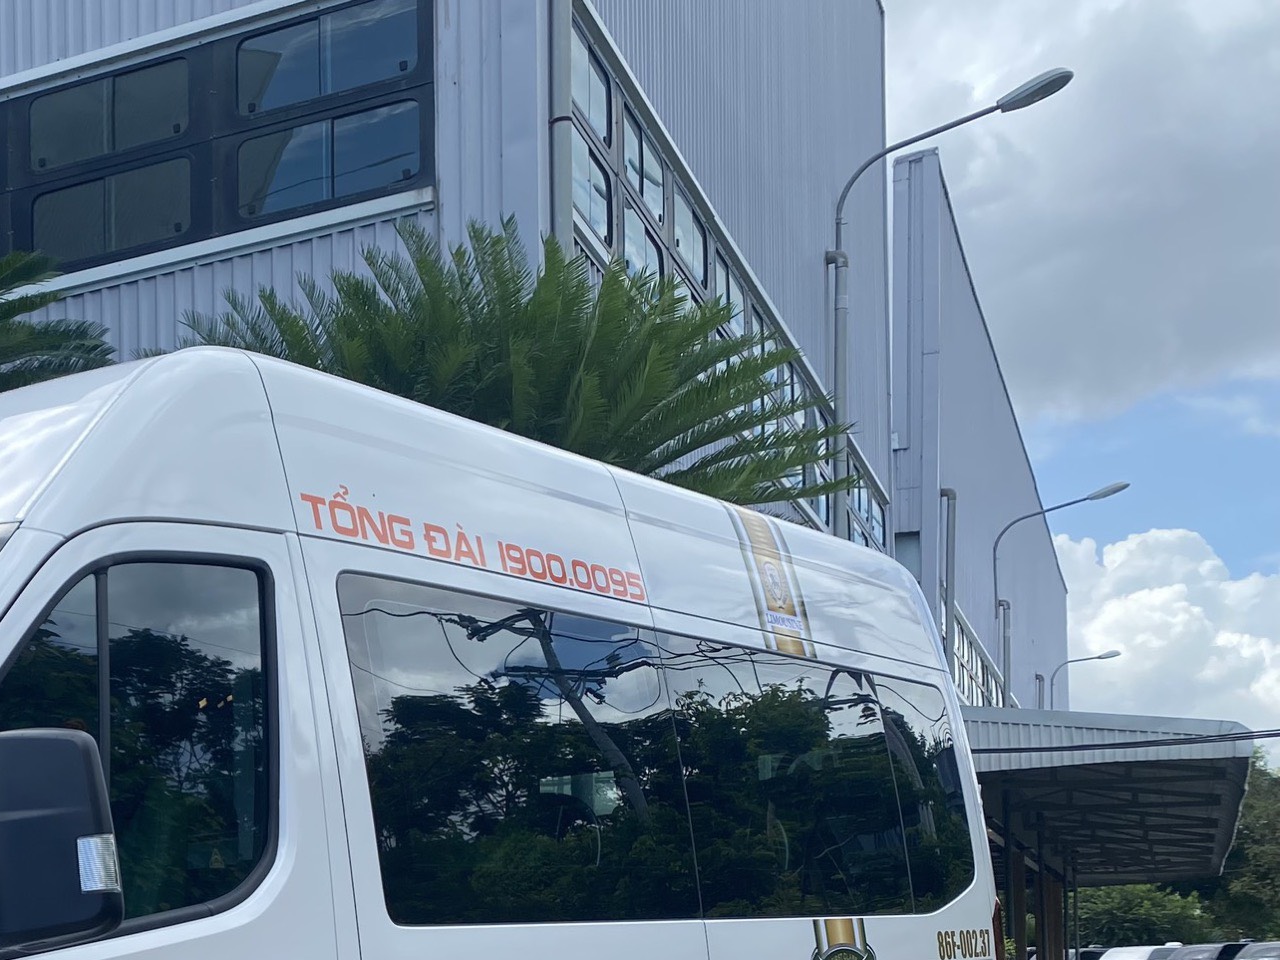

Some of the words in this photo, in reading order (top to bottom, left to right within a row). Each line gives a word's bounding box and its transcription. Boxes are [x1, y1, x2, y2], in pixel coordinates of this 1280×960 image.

[300, 484, 415, 550] TỔNG
[423, 502, 486, 567] ĐÀI
[497, 540, 646, 601] 1900.0095
[766, 612, 804, 631] LIMOUSINE
[937, 929, 991, 960] 86F-002.37
